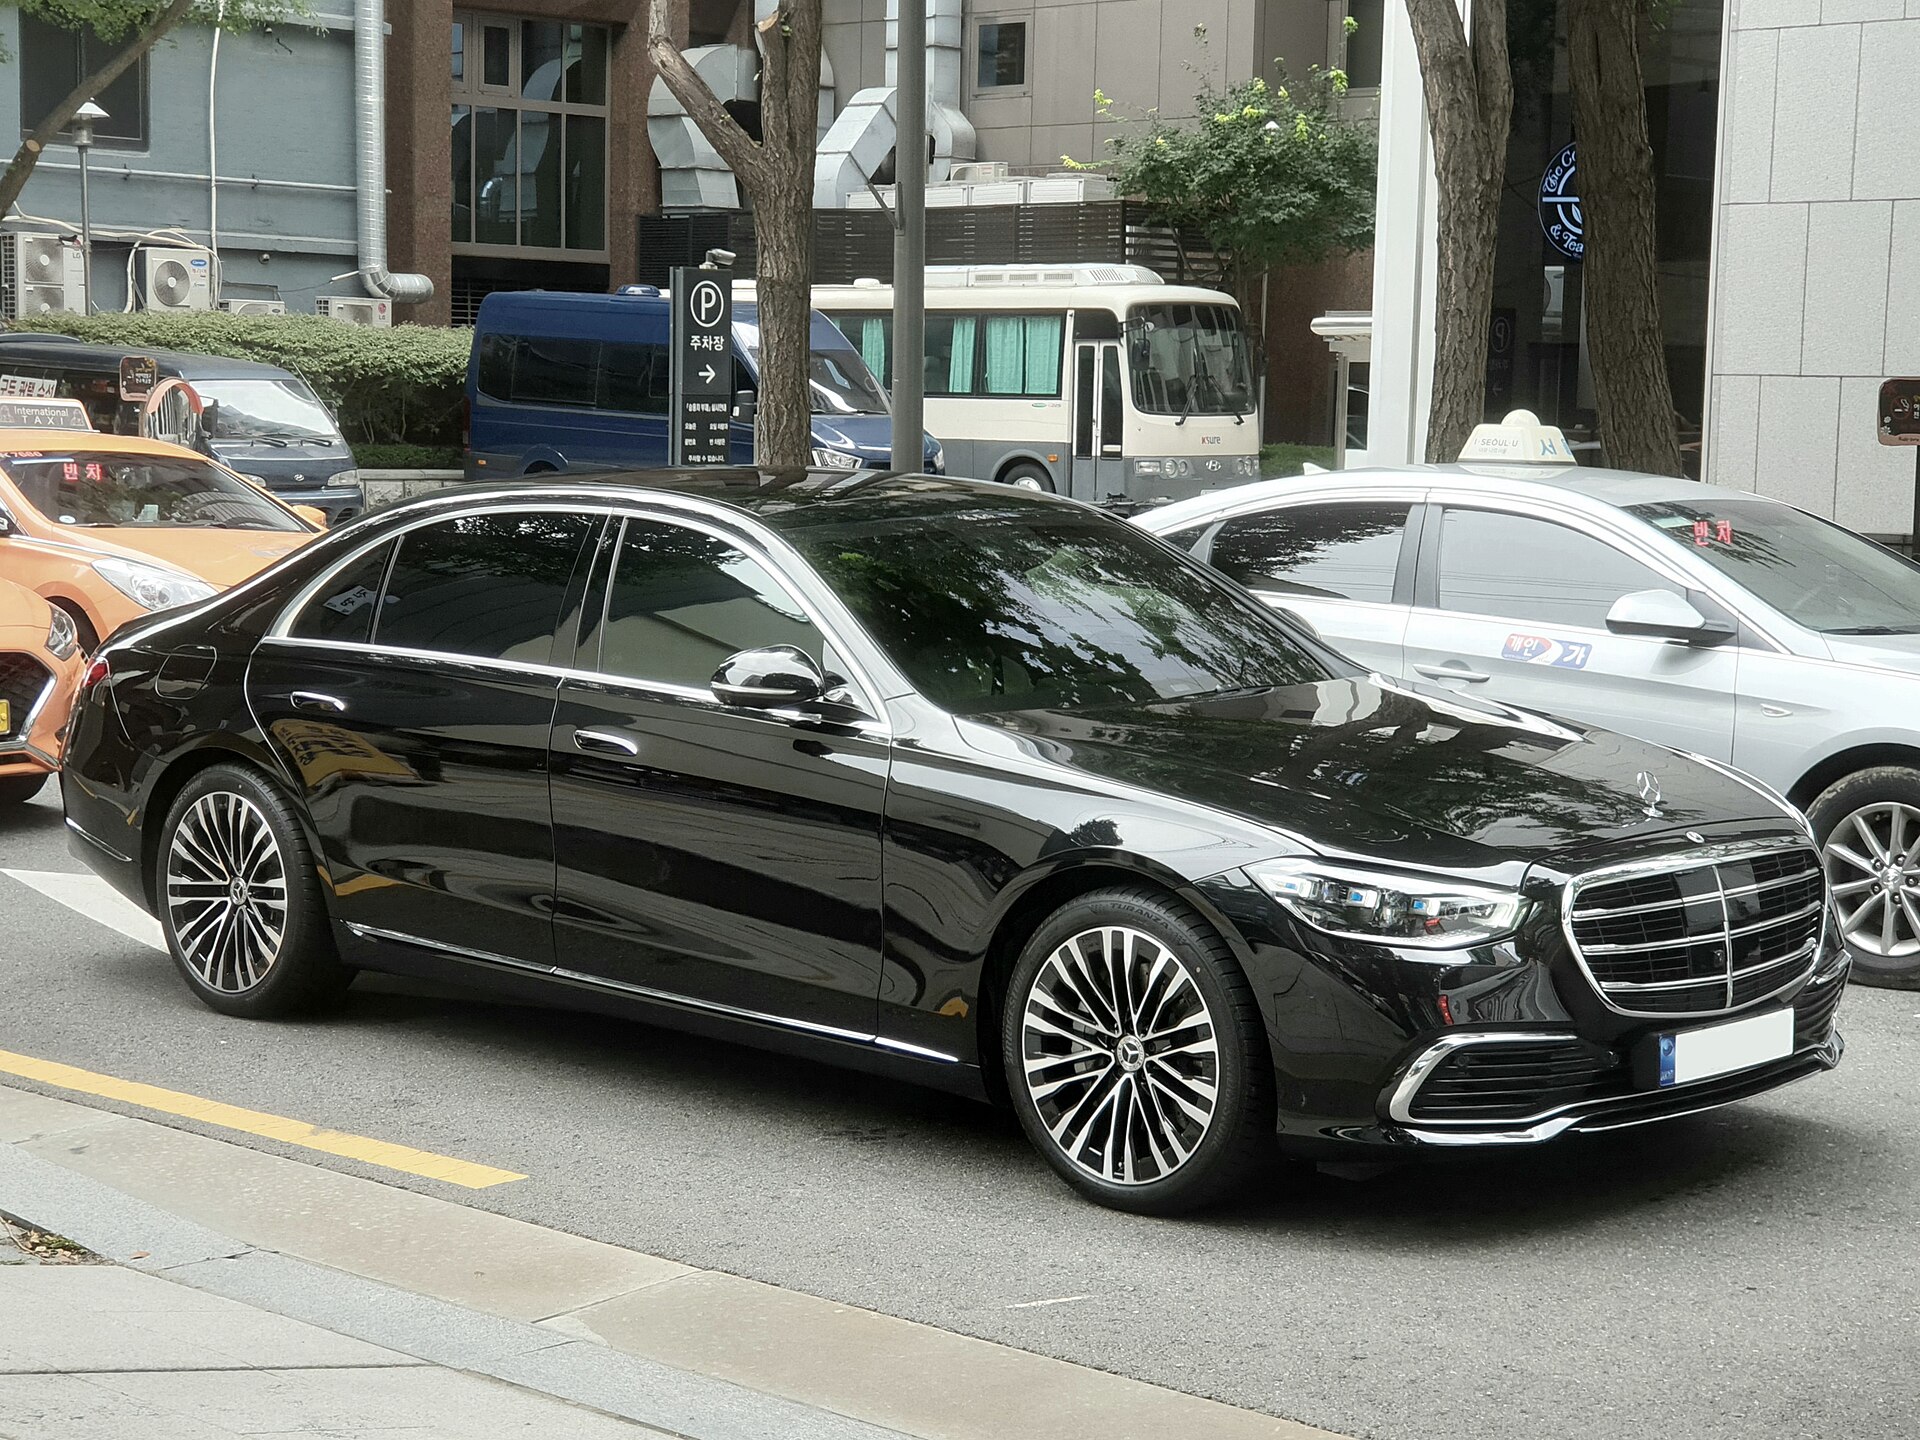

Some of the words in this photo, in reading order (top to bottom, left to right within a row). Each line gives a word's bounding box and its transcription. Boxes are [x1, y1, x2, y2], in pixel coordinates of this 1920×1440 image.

[1550, 224, 1562, 240] &
[701, 288, 716, 320] P
[690, 335, 724, 351] 주차장
[14, 406, 69, 417] International
[23, 416, 64, 425] TAXI
[1509, 635, 1540, 657] 개인
[1110, 903, 1169, 930] TURANZA
